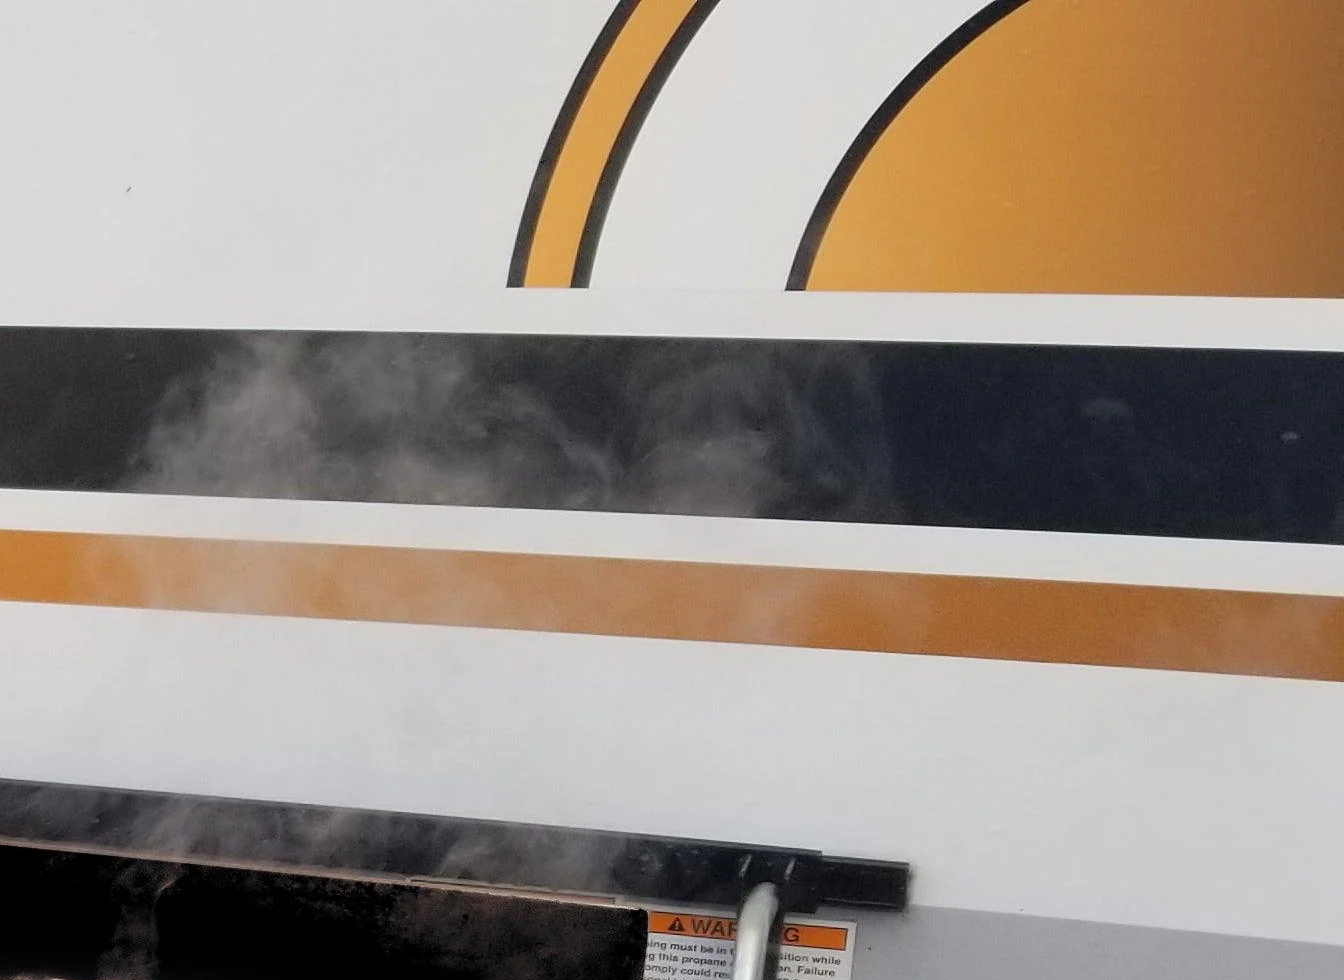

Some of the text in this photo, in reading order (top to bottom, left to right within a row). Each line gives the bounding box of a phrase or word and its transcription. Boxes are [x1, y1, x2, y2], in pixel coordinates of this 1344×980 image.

[670, 943, 697, 952] must
[700, 945, 714, 953] be
[716, 946, 727, 954] in
[658, 953, 679, 962] this
[681, 956, 727, 967] propane
[810, 955, 842, 965] while
[644, 964, 678, 975] omply
[680, 968, 711, 977] could
[797, 965, 836, 977] Failure
